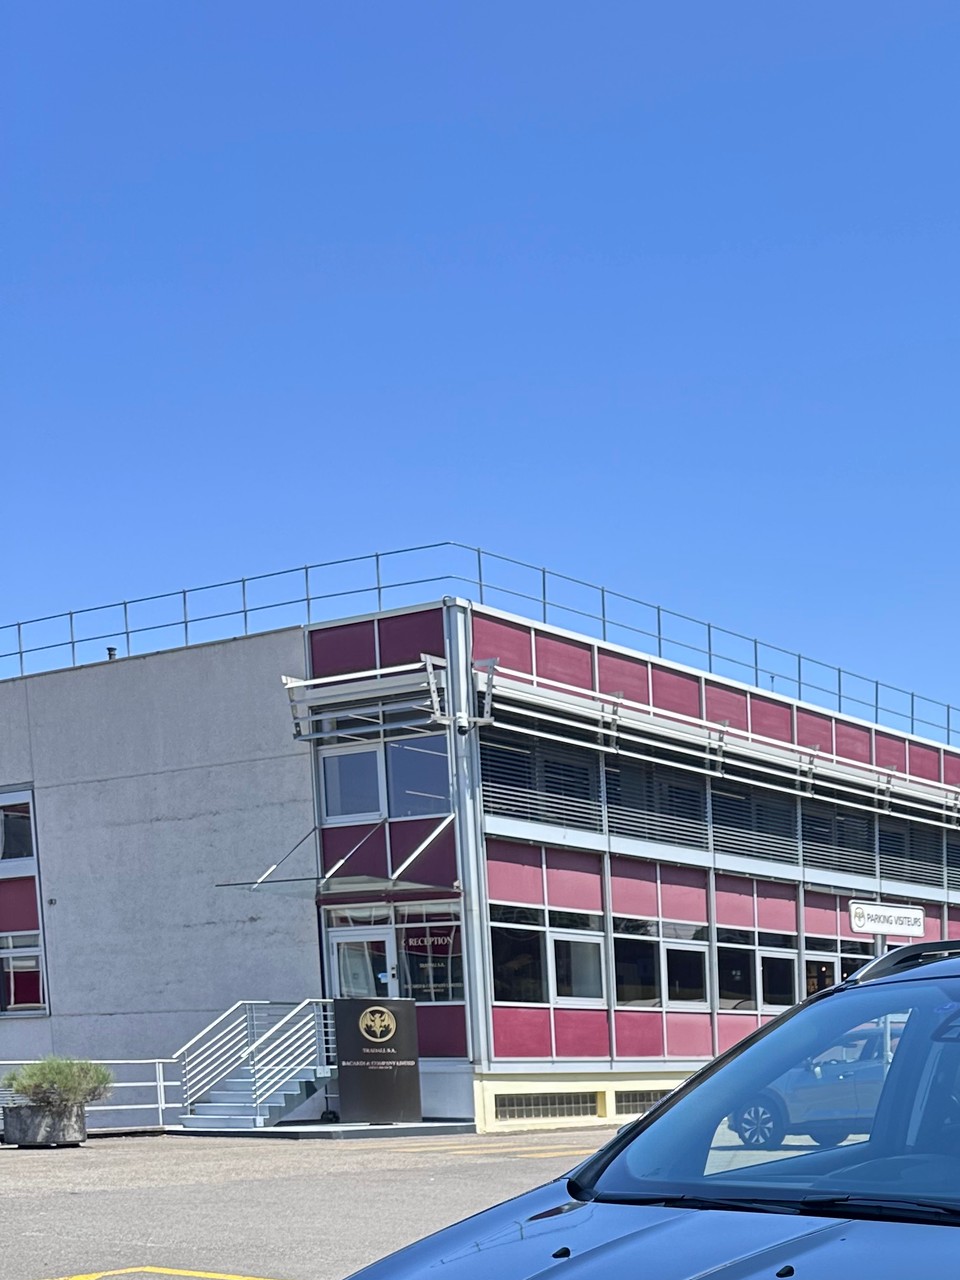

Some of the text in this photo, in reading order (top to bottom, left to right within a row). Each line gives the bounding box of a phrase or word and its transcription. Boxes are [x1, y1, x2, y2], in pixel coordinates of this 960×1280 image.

[866, 913, 922, 927] PARKING VISITEURS
[408, 936, 453, 946] RECEPTION
